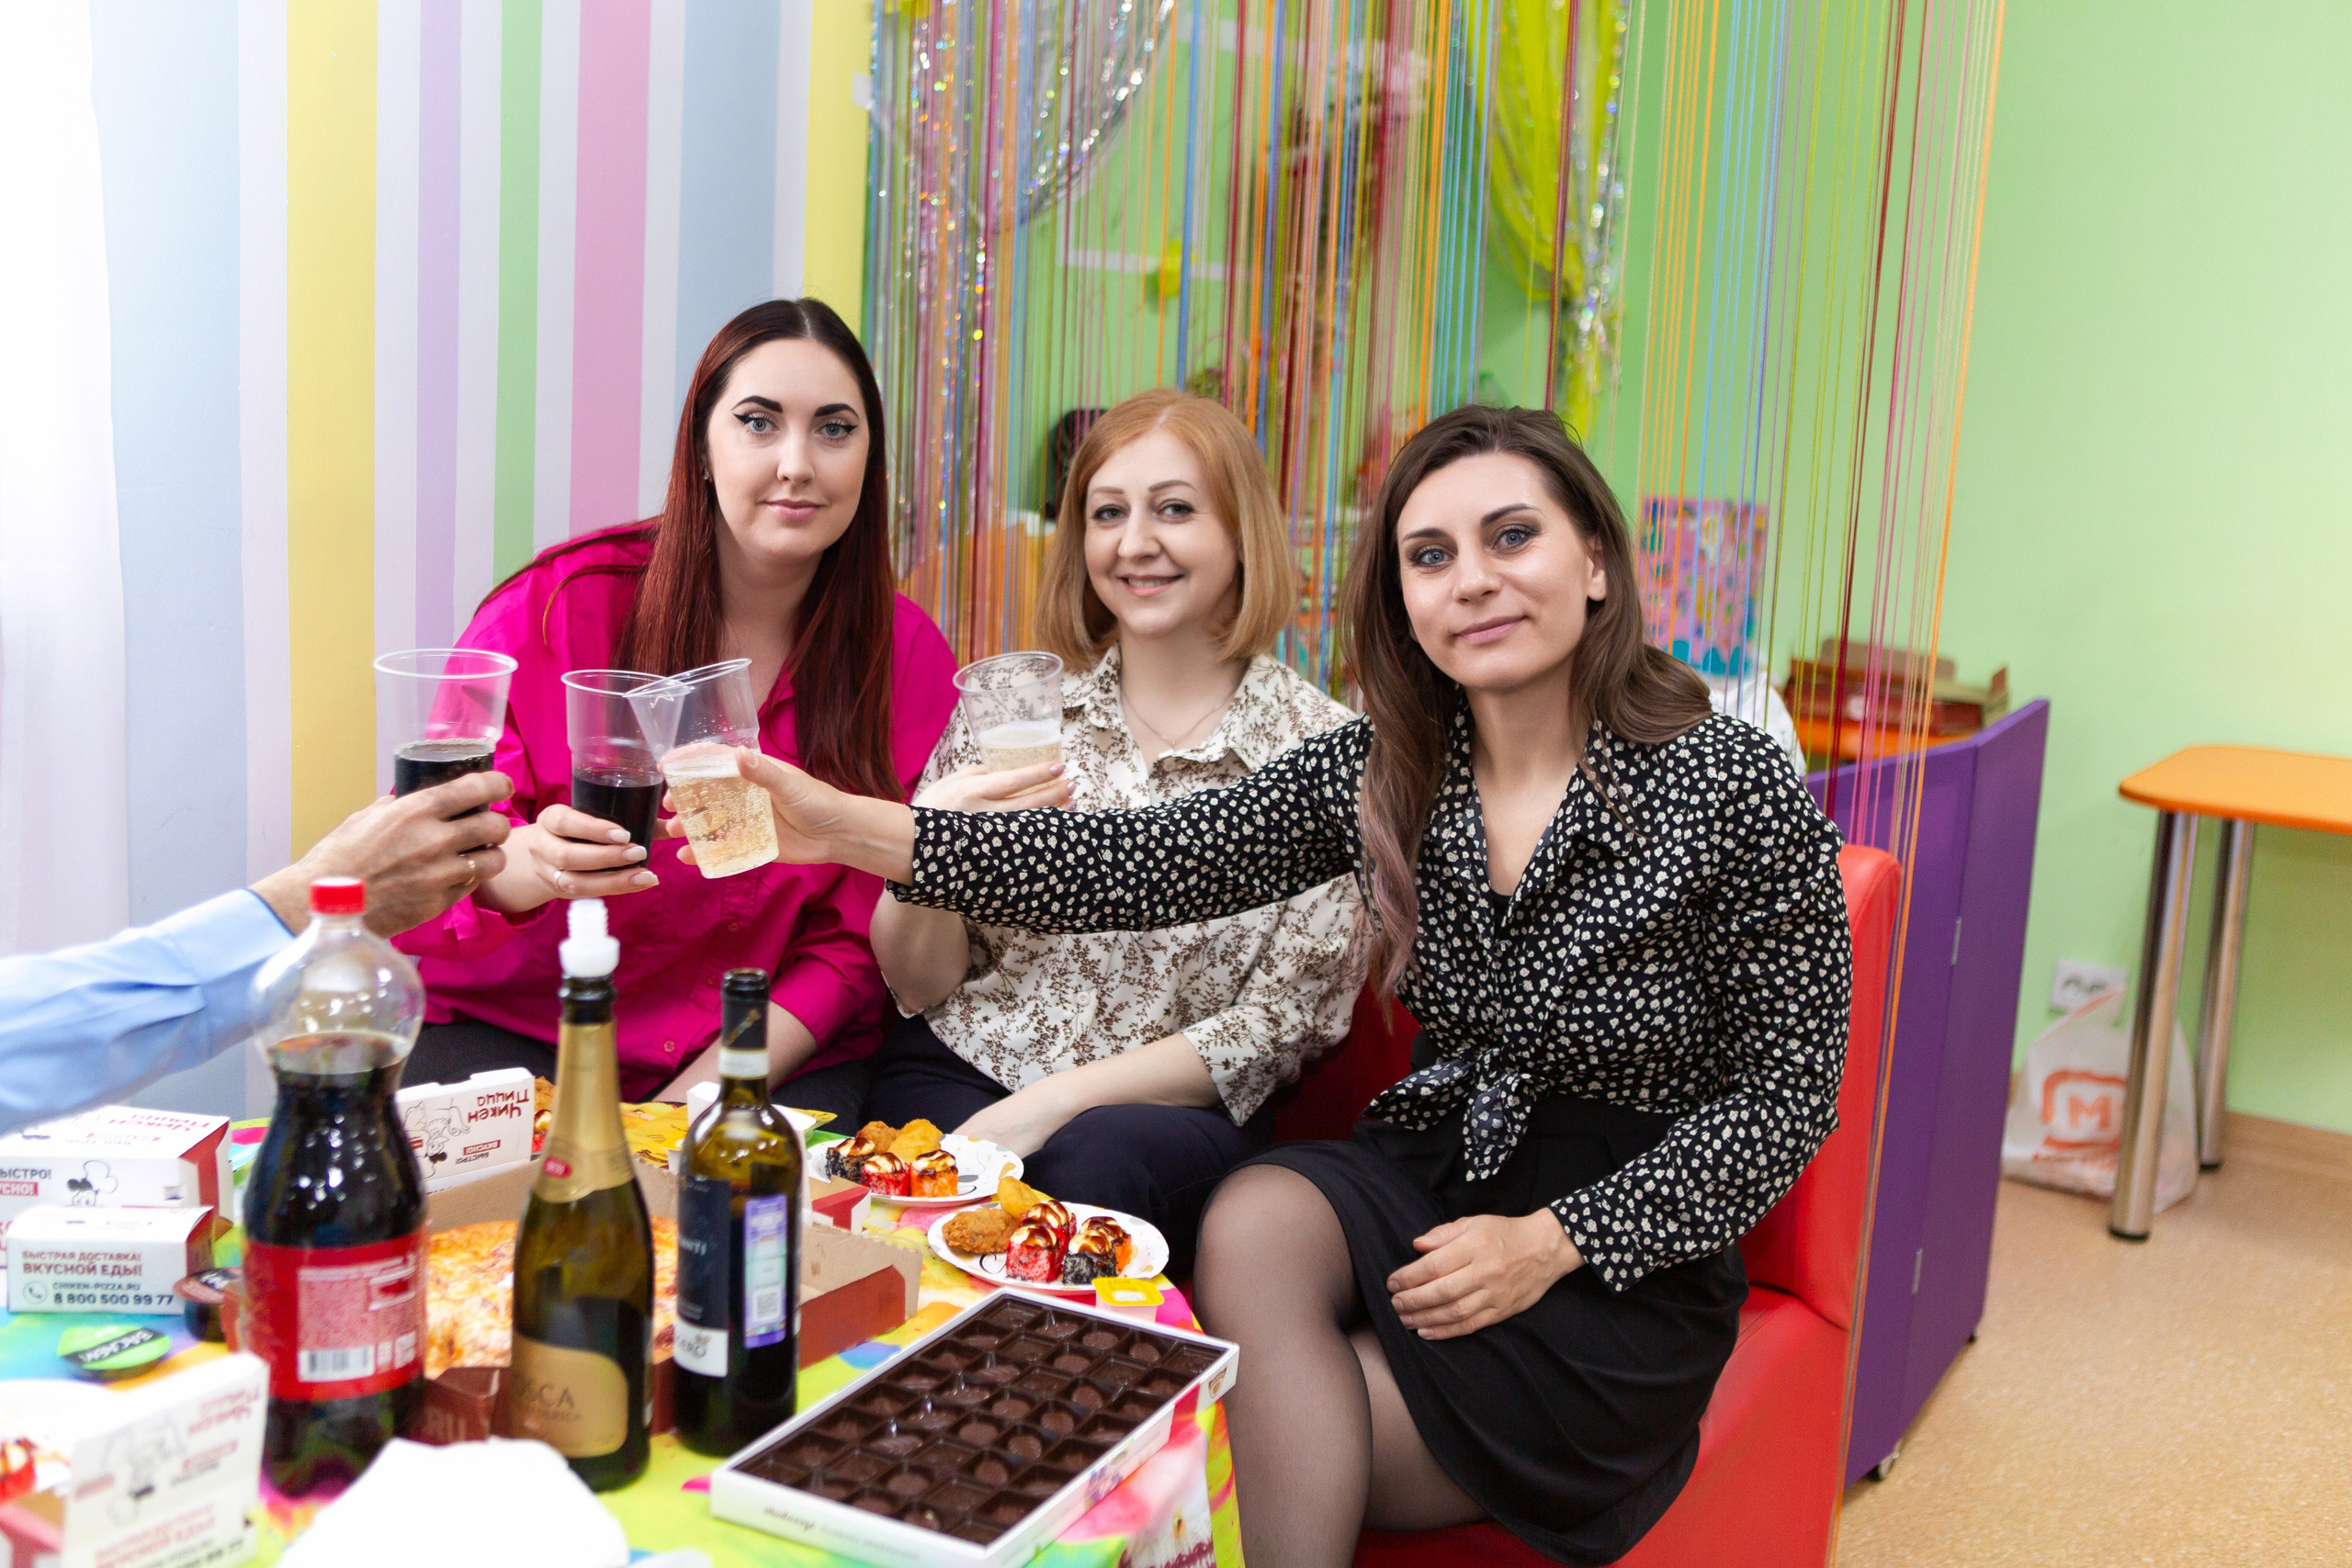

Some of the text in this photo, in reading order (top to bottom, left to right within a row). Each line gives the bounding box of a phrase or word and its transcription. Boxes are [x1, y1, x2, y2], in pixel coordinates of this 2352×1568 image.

[477, 1089, 530, 1107] Пицца
[468, 1103, 522, 1123] Чикен
[0, 1168, 51, 1180] ЫСТРО!
[22, 1250, 141, 1263] БЫСТРАЯ ДОСТАВКА!
[23, 1261, 97, 1276] ВКУСНОЙ
[54, 1293, 174, 1305] 8 800 500 99 77
